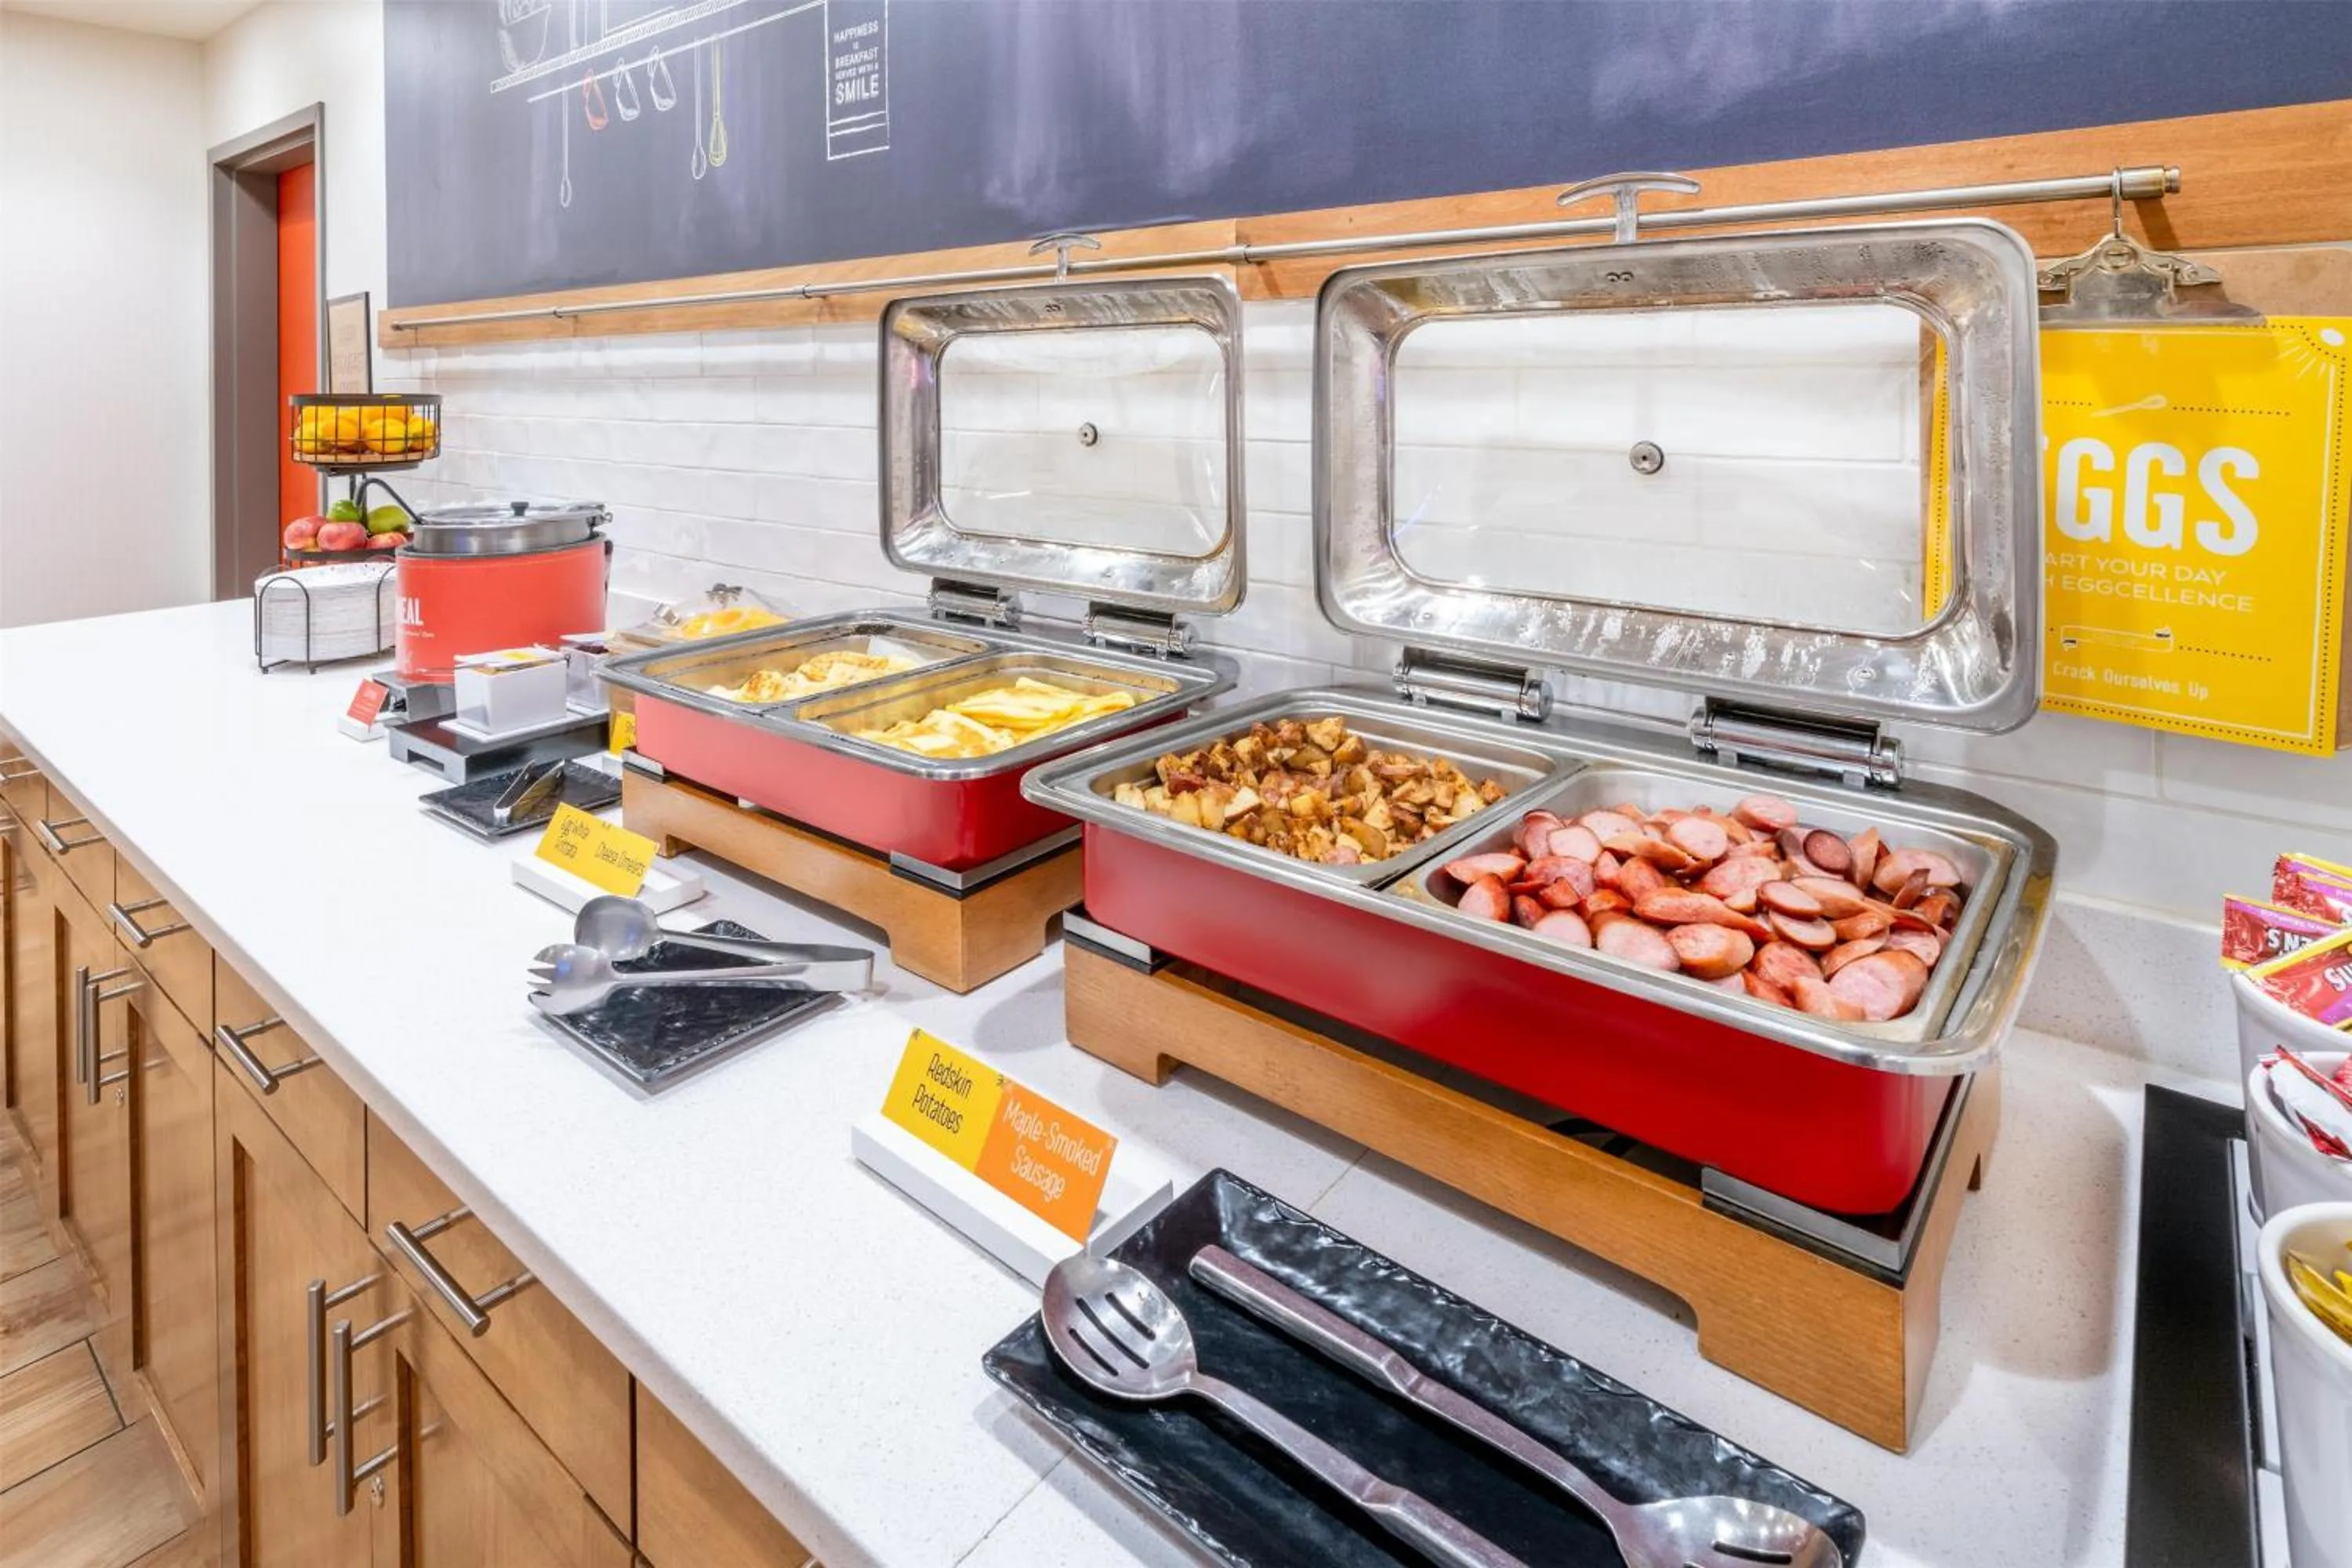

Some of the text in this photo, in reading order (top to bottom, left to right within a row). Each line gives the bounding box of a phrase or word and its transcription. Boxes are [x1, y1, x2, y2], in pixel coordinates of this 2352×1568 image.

[833, 20, 878, 44] HAPPINESS
[835, 46, 878, 69] BREAKFAST
[836, 67, 856, 81] SERVED
[858, 63, 873, 74] WITH
[835, 73, 879, 105] SMILE
[2043, 436, 2260, 557] GGS
[2045, 552, 2227, 586] ART YOUR DAY
[400, 597, 424, 626] EAL
[2062, 575, 2256, 613] EGGCELLENCE
[2052, 661, 2209, 702] Crack Ourselves Up
[927, 1052, 974, 1099] Redskin
[912, 1083, 964, 1134] Potatoes
[1003, 1100, 1102, 1176] Maple-Smoked
[1011, 1145, 1065, 1203] Sausage
